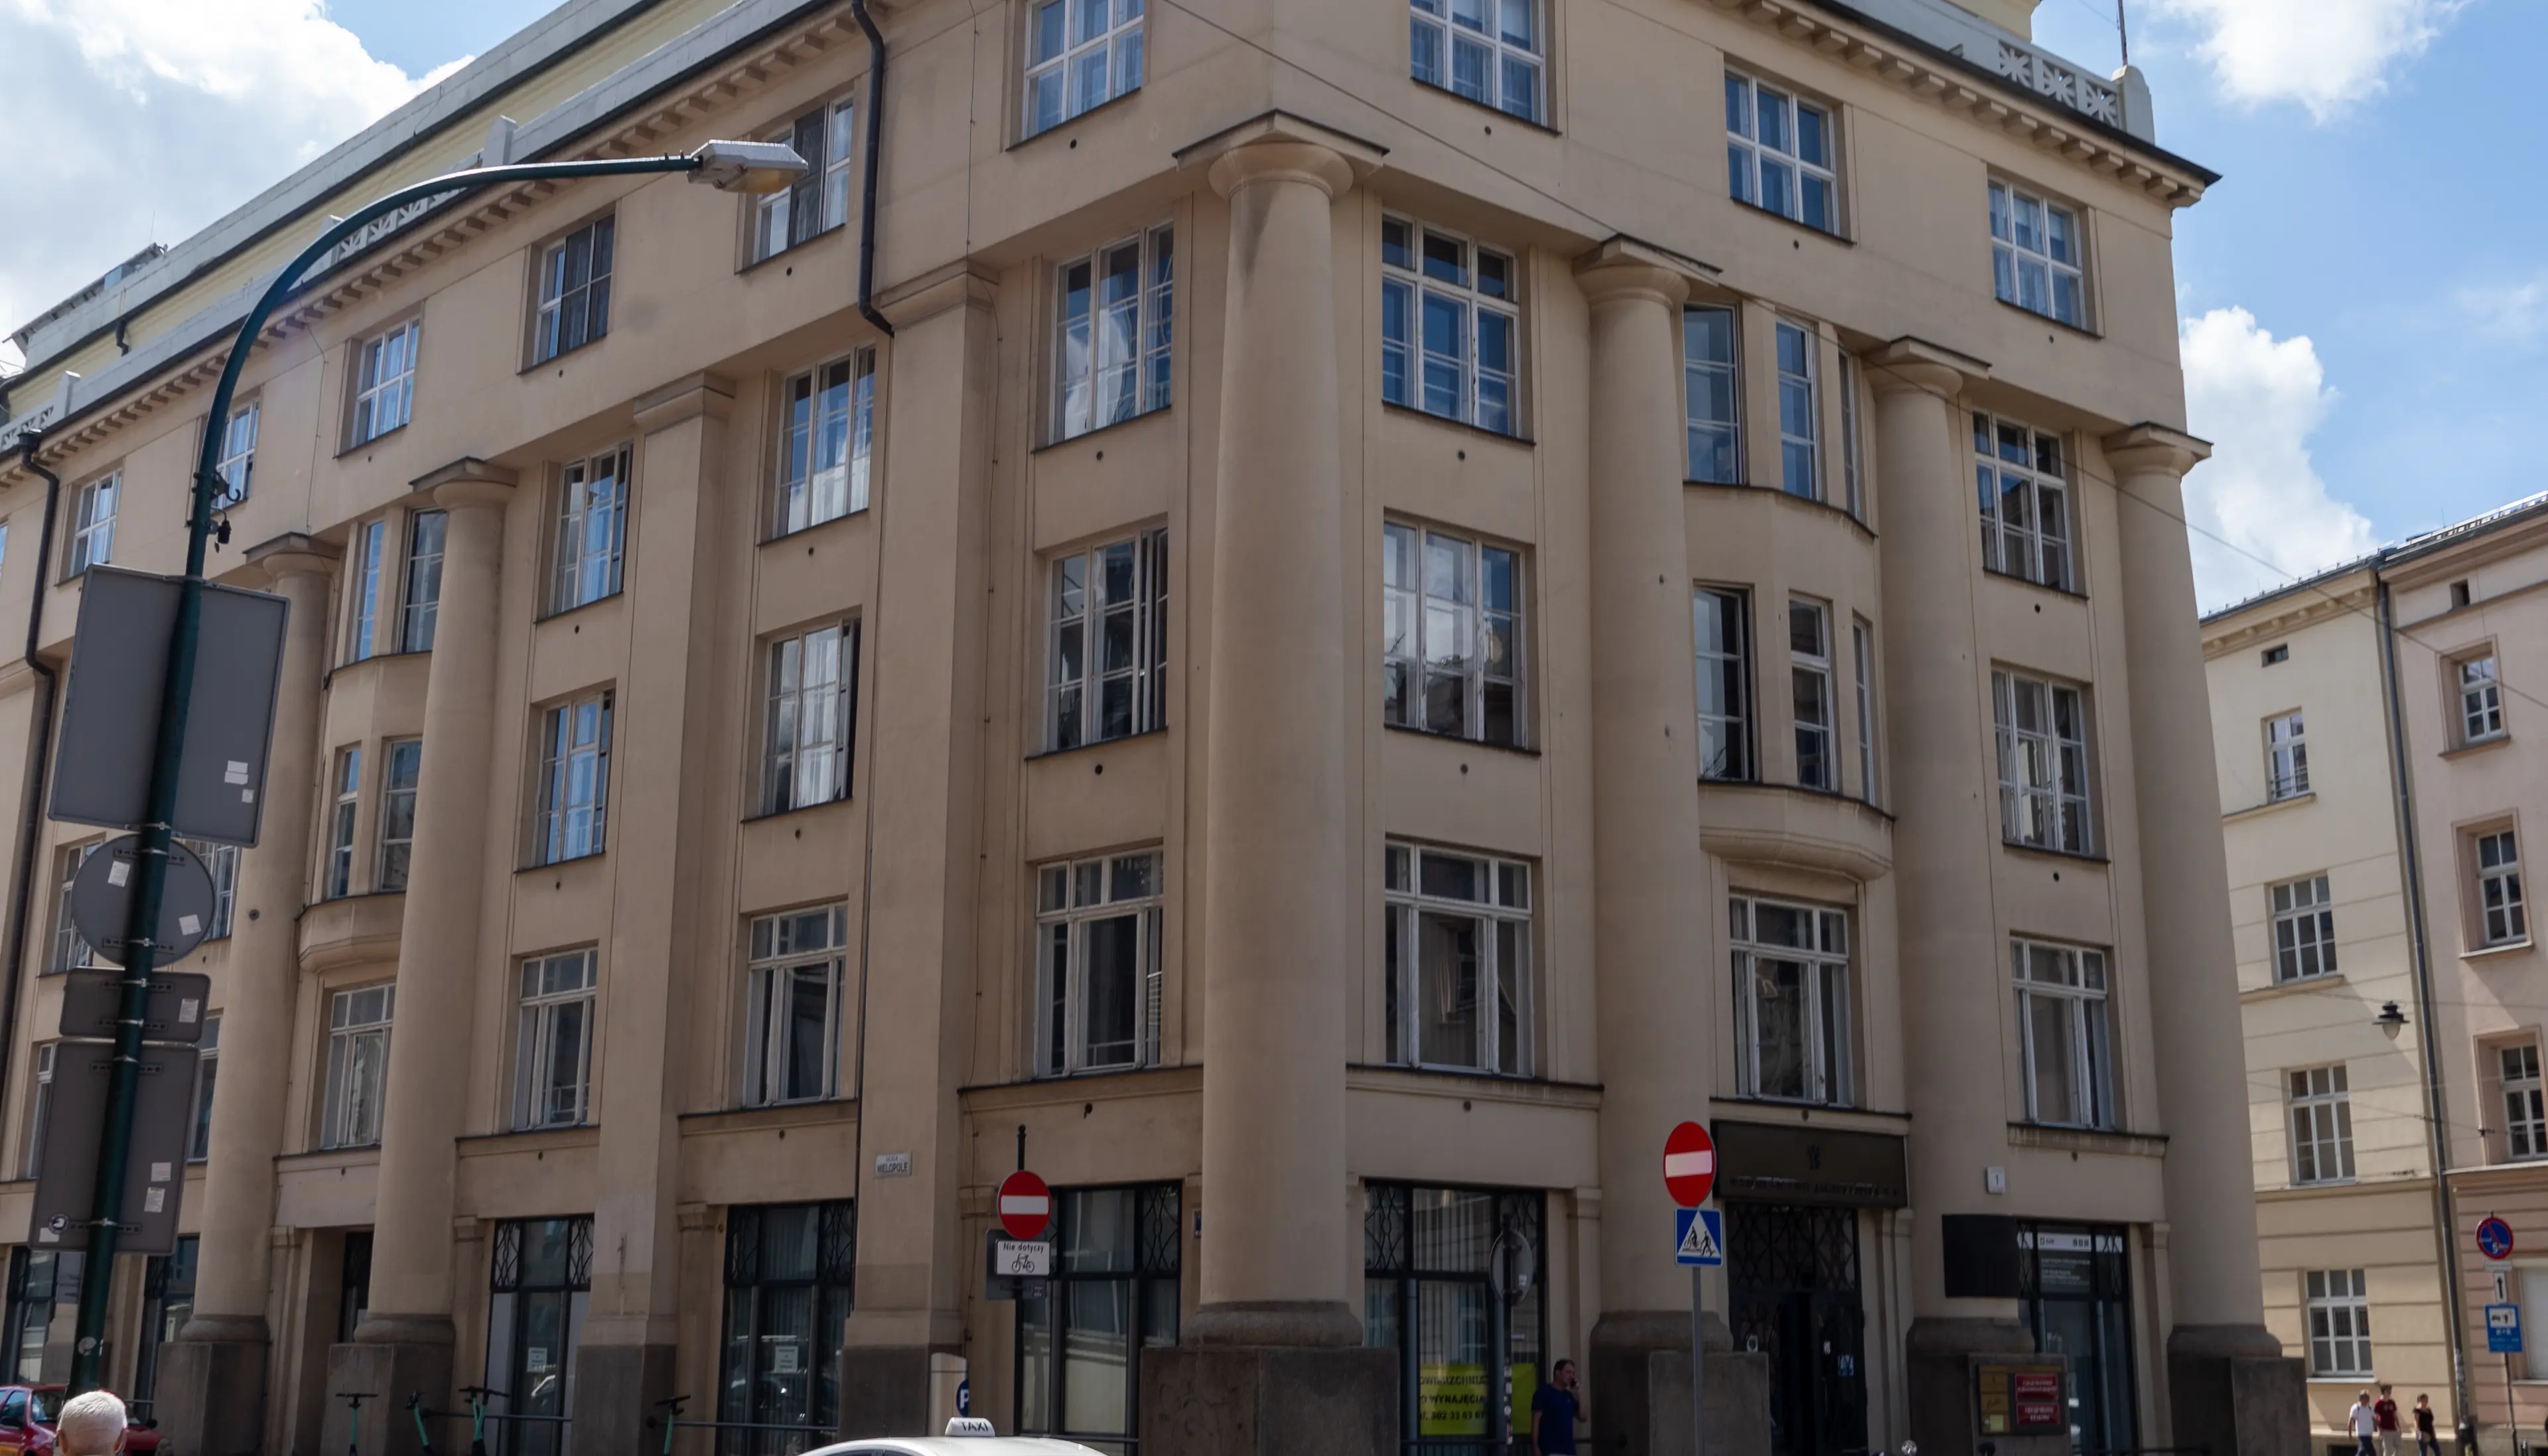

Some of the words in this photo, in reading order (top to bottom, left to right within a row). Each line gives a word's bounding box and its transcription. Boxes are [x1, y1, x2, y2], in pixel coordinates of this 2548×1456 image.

[877, 1161, 908, 1173] WIELOPOLE
[1003, 1242, 1015, 1251] Nie
[1018, 1242, 1044, 1254] dotyczy
[959, 1388, 969, 1409] P
[959, 1422, 989, 1431] TAXI
